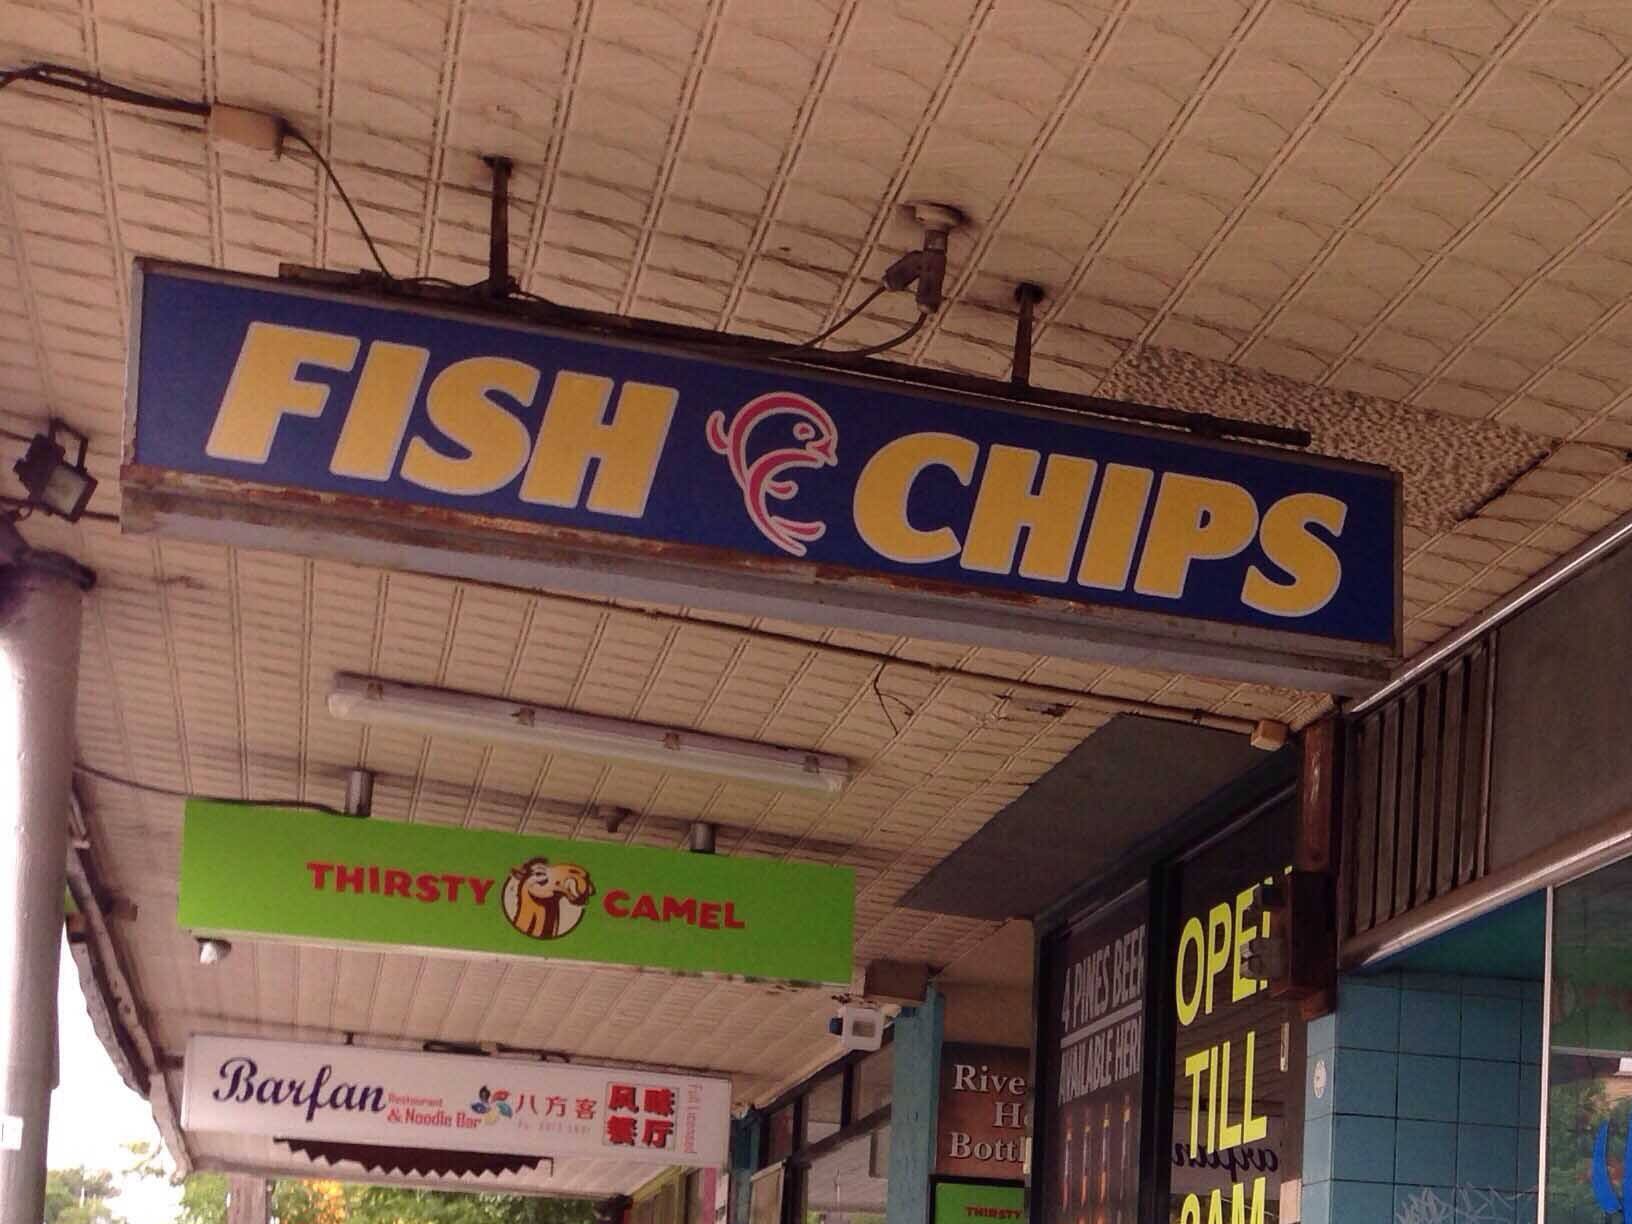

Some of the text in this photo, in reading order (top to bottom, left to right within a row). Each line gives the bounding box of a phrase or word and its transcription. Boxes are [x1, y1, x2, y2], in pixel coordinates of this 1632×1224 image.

[205, 321, 1349, 618] FISH CHIPS
[306, 861, 747, 931] THIRSTY CAMEL
[1175, 865, 1293, 1027] OPE
[1061, 966, 1071, 1033] 4
[1073, 944, 1111, 1028] PINES
[212, 1056, 386, 1122] Barfan
[514, 1093, 597, 1121] 八方客
[1057, 1028, 1114, 1108] AVAILABLE
[1185, 1031, 1268, 1159] TILL
[387, 1108, 402, 1122] &
[456, 1112, 481, 1128] Bar
